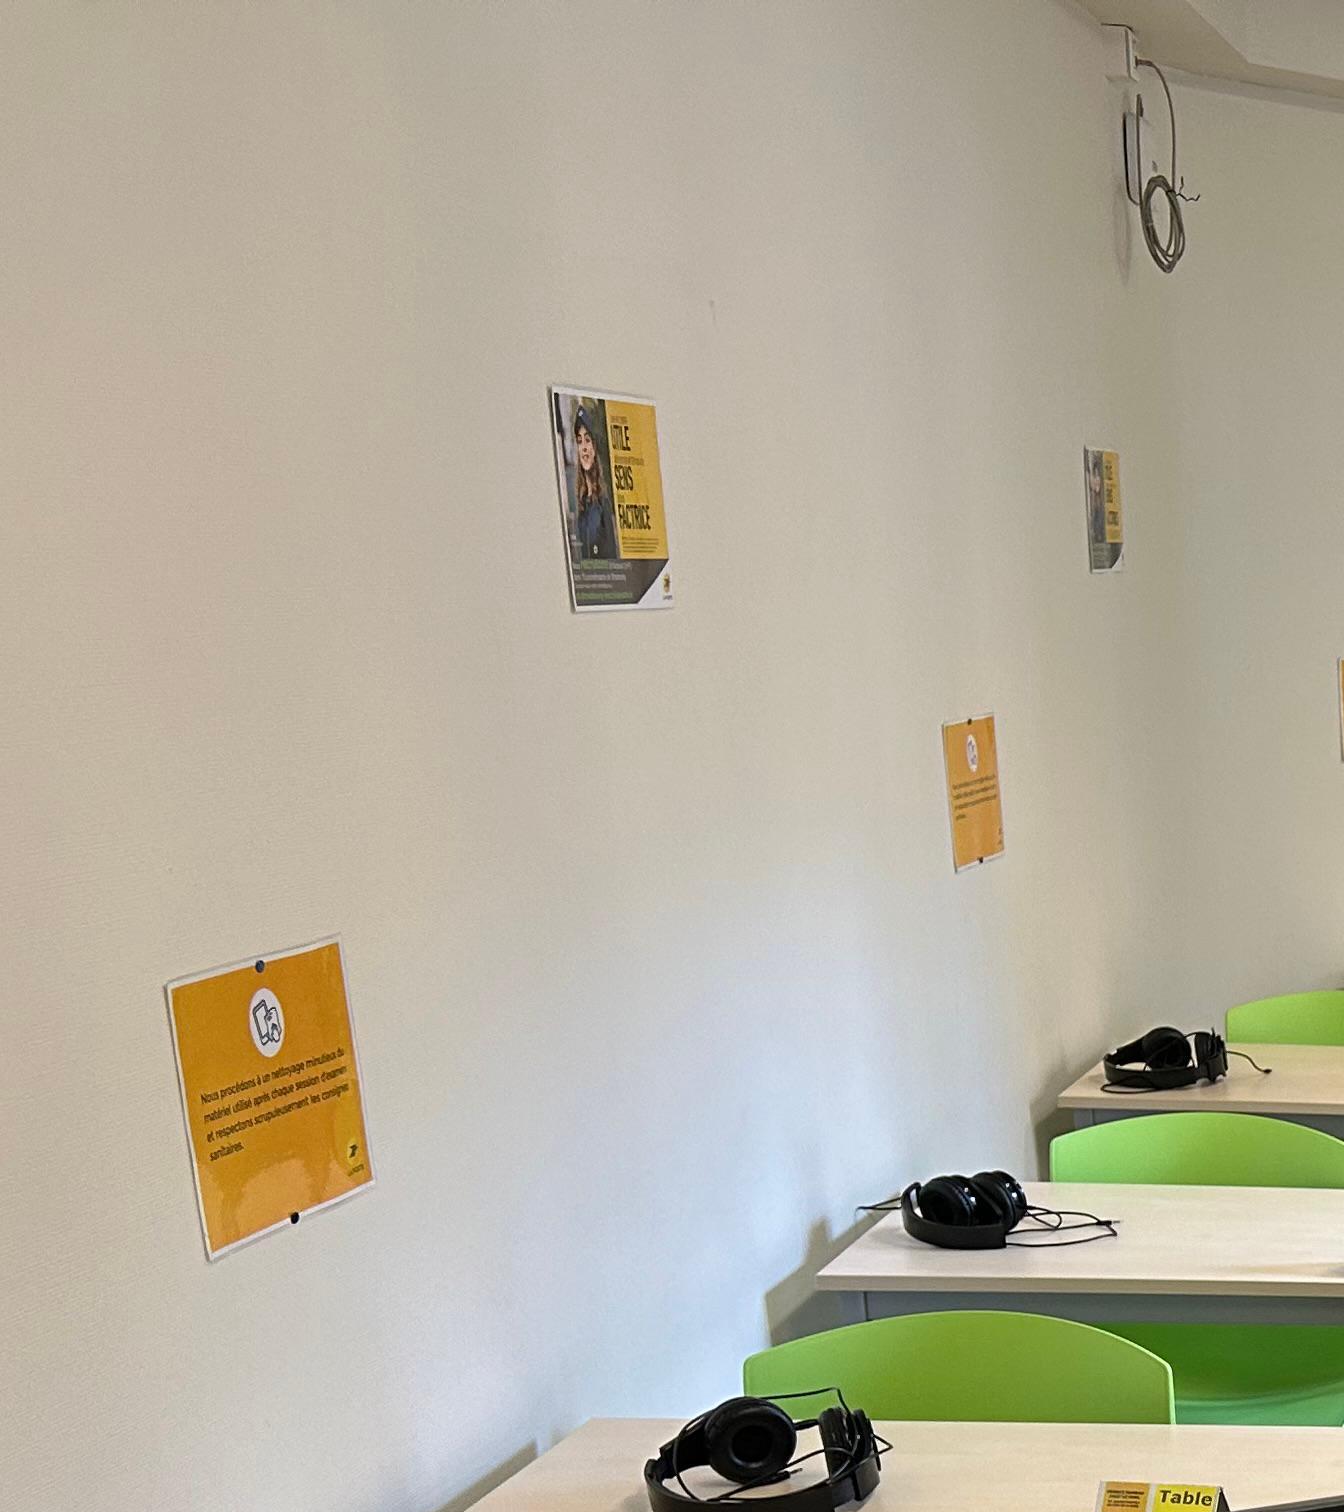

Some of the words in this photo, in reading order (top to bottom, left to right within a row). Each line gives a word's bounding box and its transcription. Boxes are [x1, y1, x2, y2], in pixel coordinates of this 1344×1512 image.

[614, 464, 634, 491] SENS
[618, 504, 651, 530] FACTRICE
[271, 1062, 304, 1079] nettoyage
[1160, 1490, 1213, 1507] Table
